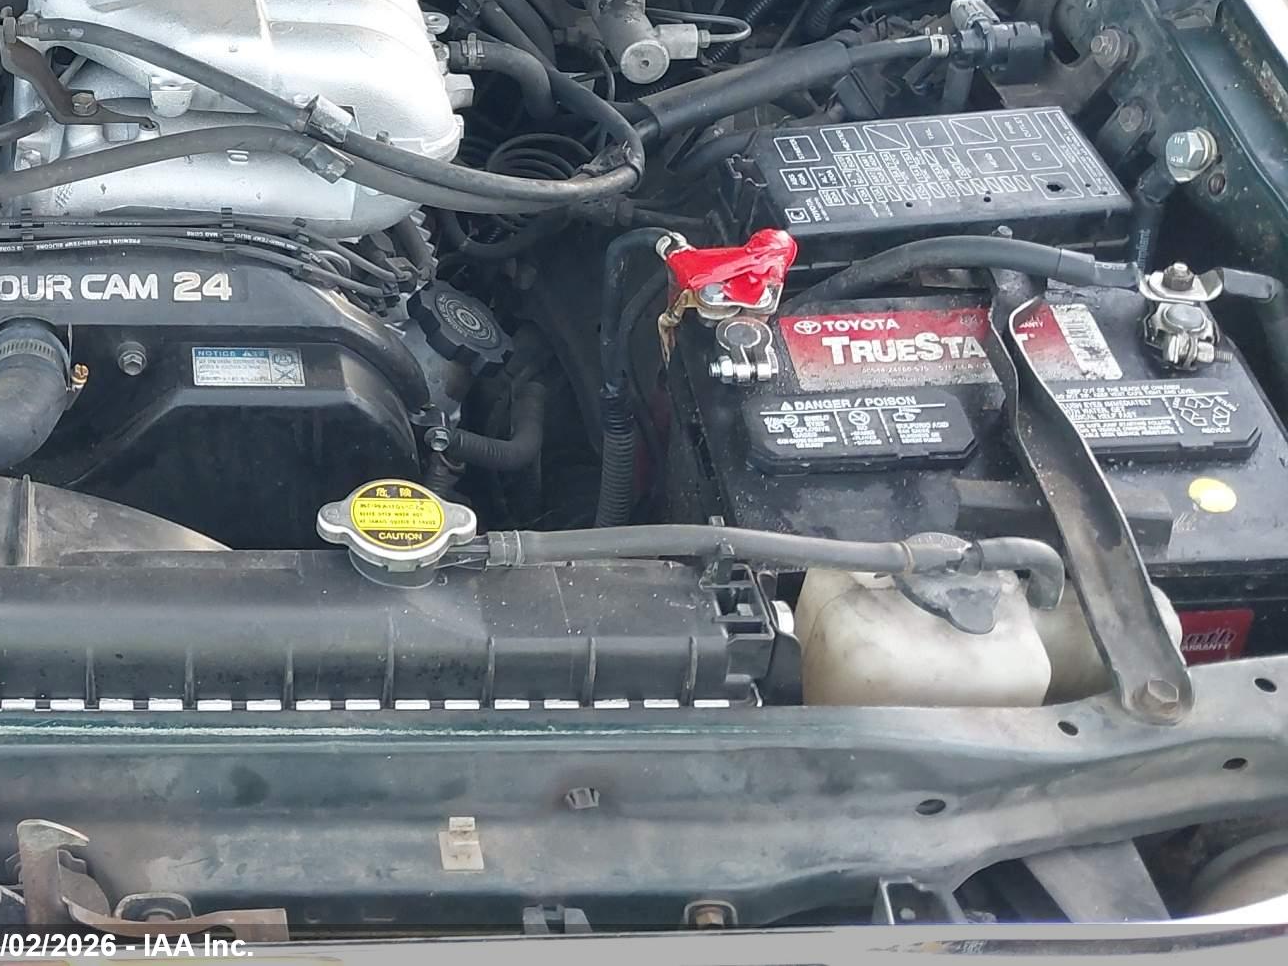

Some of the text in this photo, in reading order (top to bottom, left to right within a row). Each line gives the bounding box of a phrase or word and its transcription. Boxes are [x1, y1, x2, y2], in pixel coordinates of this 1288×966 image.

[80, 272, 159, 301] CAM
[172, 270, 233, 302] 24
[823, 318, 900, 332] TOYOTA
[794, 396, 917, 411] DANGER / POISON
[378, 531, 423, 540] CAUTION
[1182, 642, 1231, 651] ARRANTY
